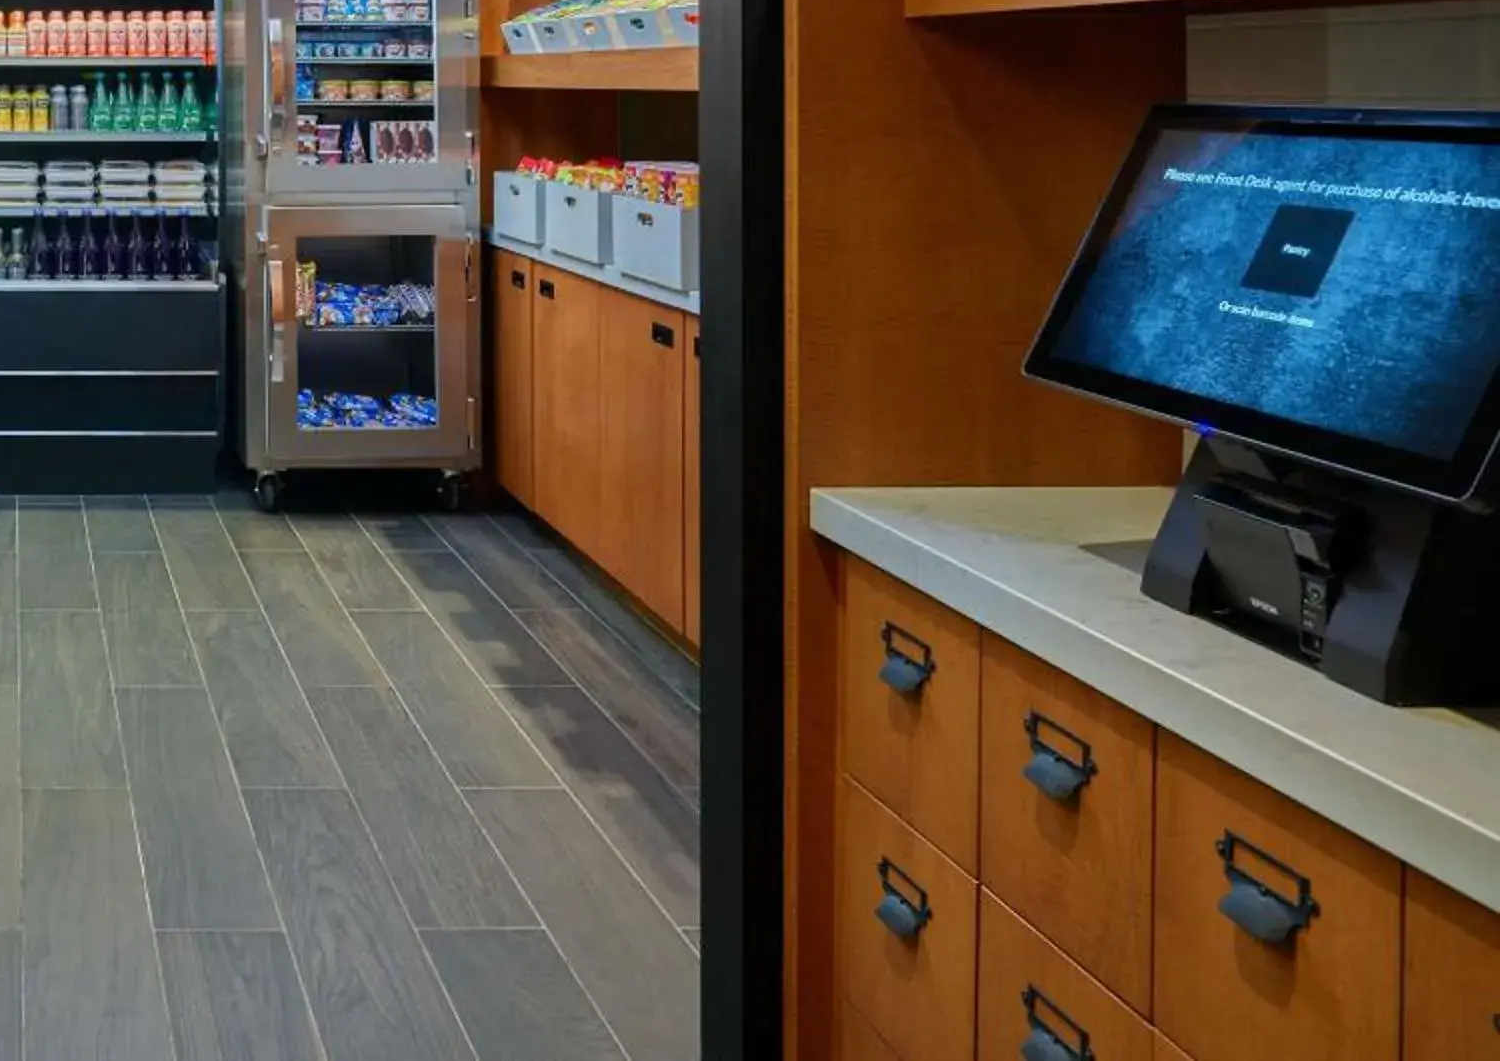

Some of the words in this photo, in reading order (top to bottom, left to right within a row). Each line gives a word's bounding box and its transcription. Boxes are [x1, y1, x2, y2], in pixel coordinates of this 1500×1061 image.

[1164, 168, 1195, 183] Please
[1195, 174, 1215, 184] see
[1215, 172, 1245, 186] Front
[1245, 175, 1273, 188] Desk
[1273, 179, 1307, 192] agent
[1307, 179, 1326, 193] for
[1326, 183, 1383, 198] purchase
[1384, 187, 1401, 200] of
[1400, 189, 1461, 205] alcoholic
